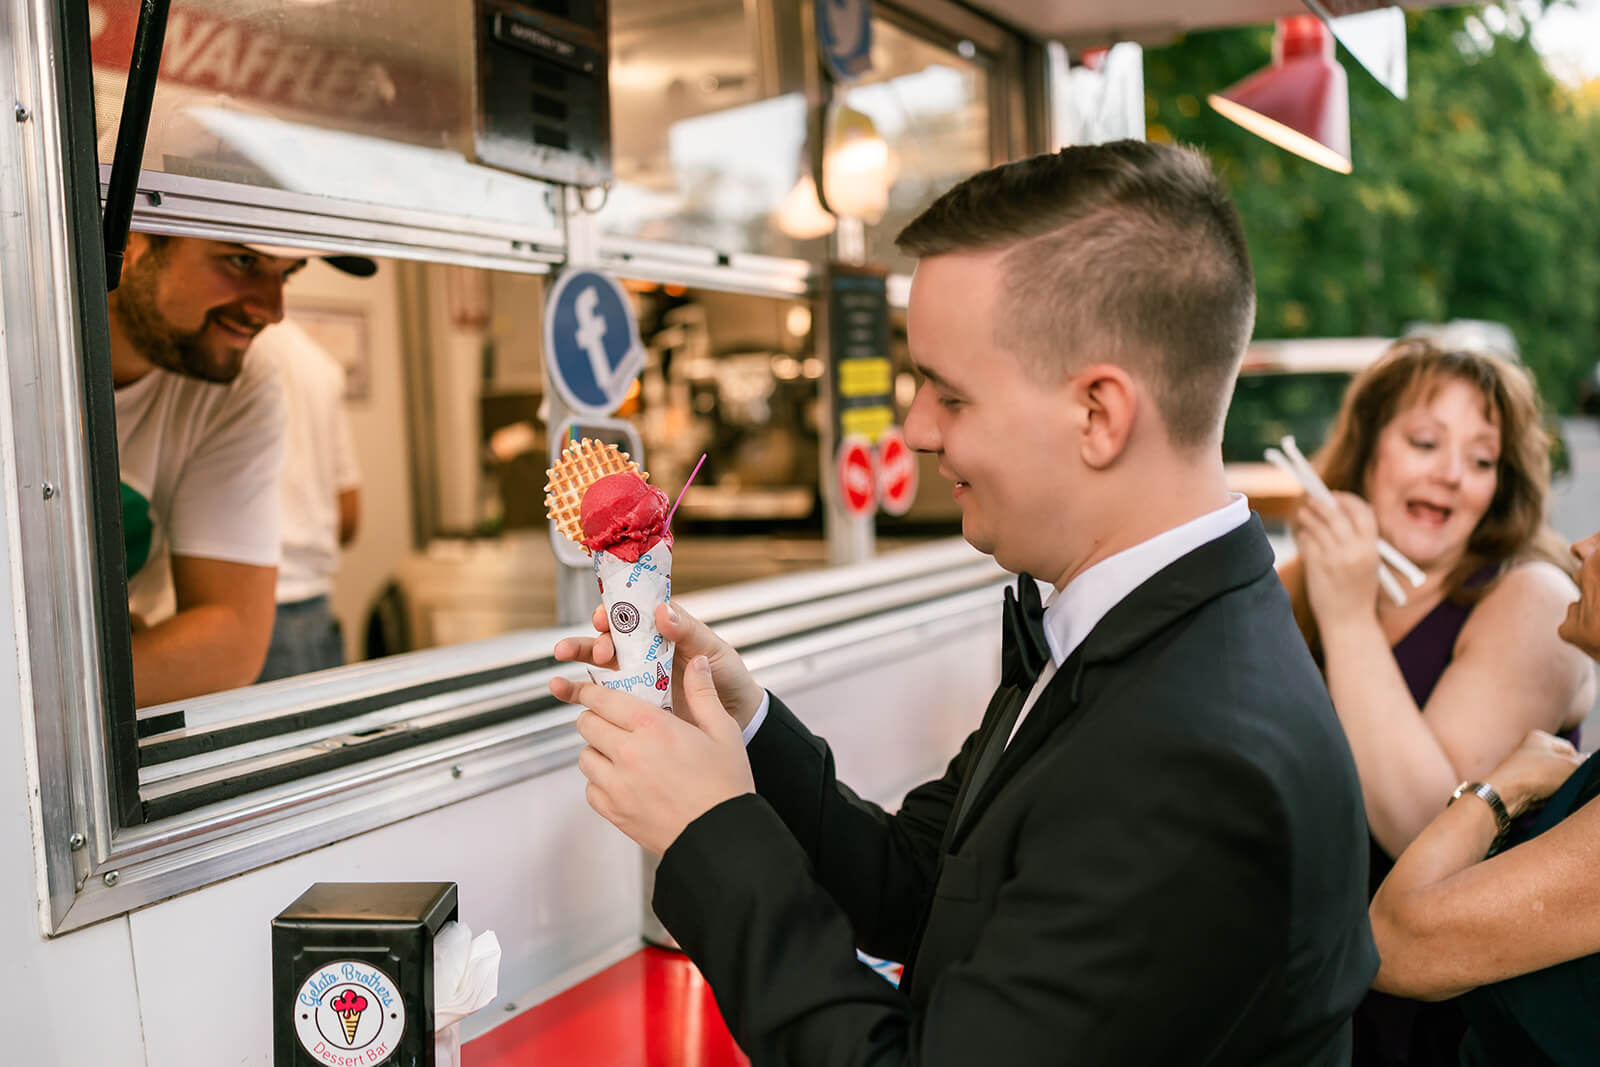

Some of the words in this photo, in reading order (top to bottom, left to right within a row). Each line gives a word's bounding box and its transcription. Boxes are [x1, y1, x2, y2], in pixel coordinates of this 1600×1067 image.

[299, 970, 339, 1007] Gelato
[342, 963, 394, 1008] Brothers
[313, 1041, 364, 1066] Dessert
[367, 1041, 388, 1062] Bar
